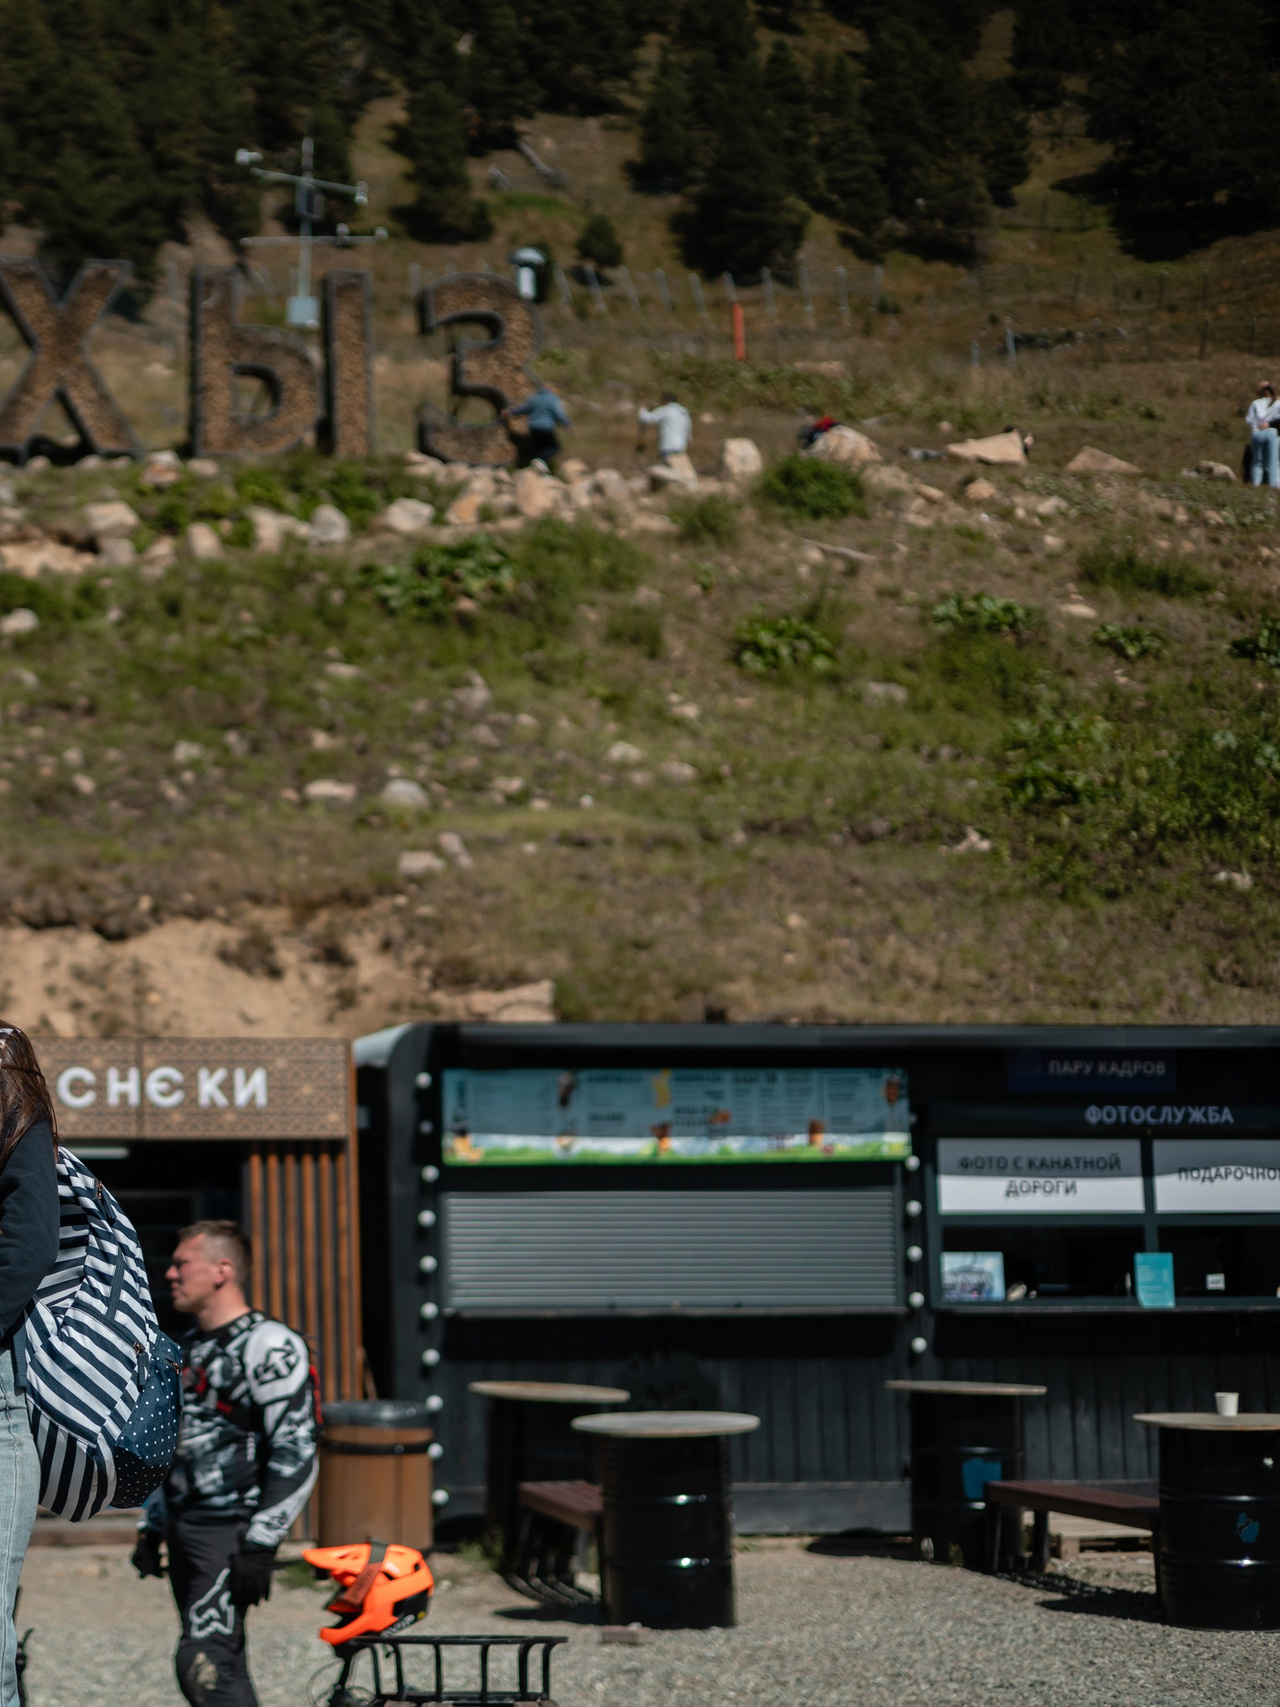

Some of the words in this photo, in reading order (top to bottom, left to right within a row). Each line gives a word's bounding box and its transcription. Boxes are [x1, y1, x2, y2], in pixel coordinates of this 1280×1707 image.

[1048, 1060, 1093, 1076] ПАРУ
[1098, 1060, 1167, 1077] КАДРОВ
[1085, 1104, 1234, 1126] ФОТОСЛУЖБА
[959, 1155, 1009, 1171] ФОТО
[1028, 1152, 1121, 1171] КАНАТНОЙ
[1178, 1166, 1280, 1184] ПОДАРОЧНО
[1004, 1180, 1077, 1198] ДОРОГИ
